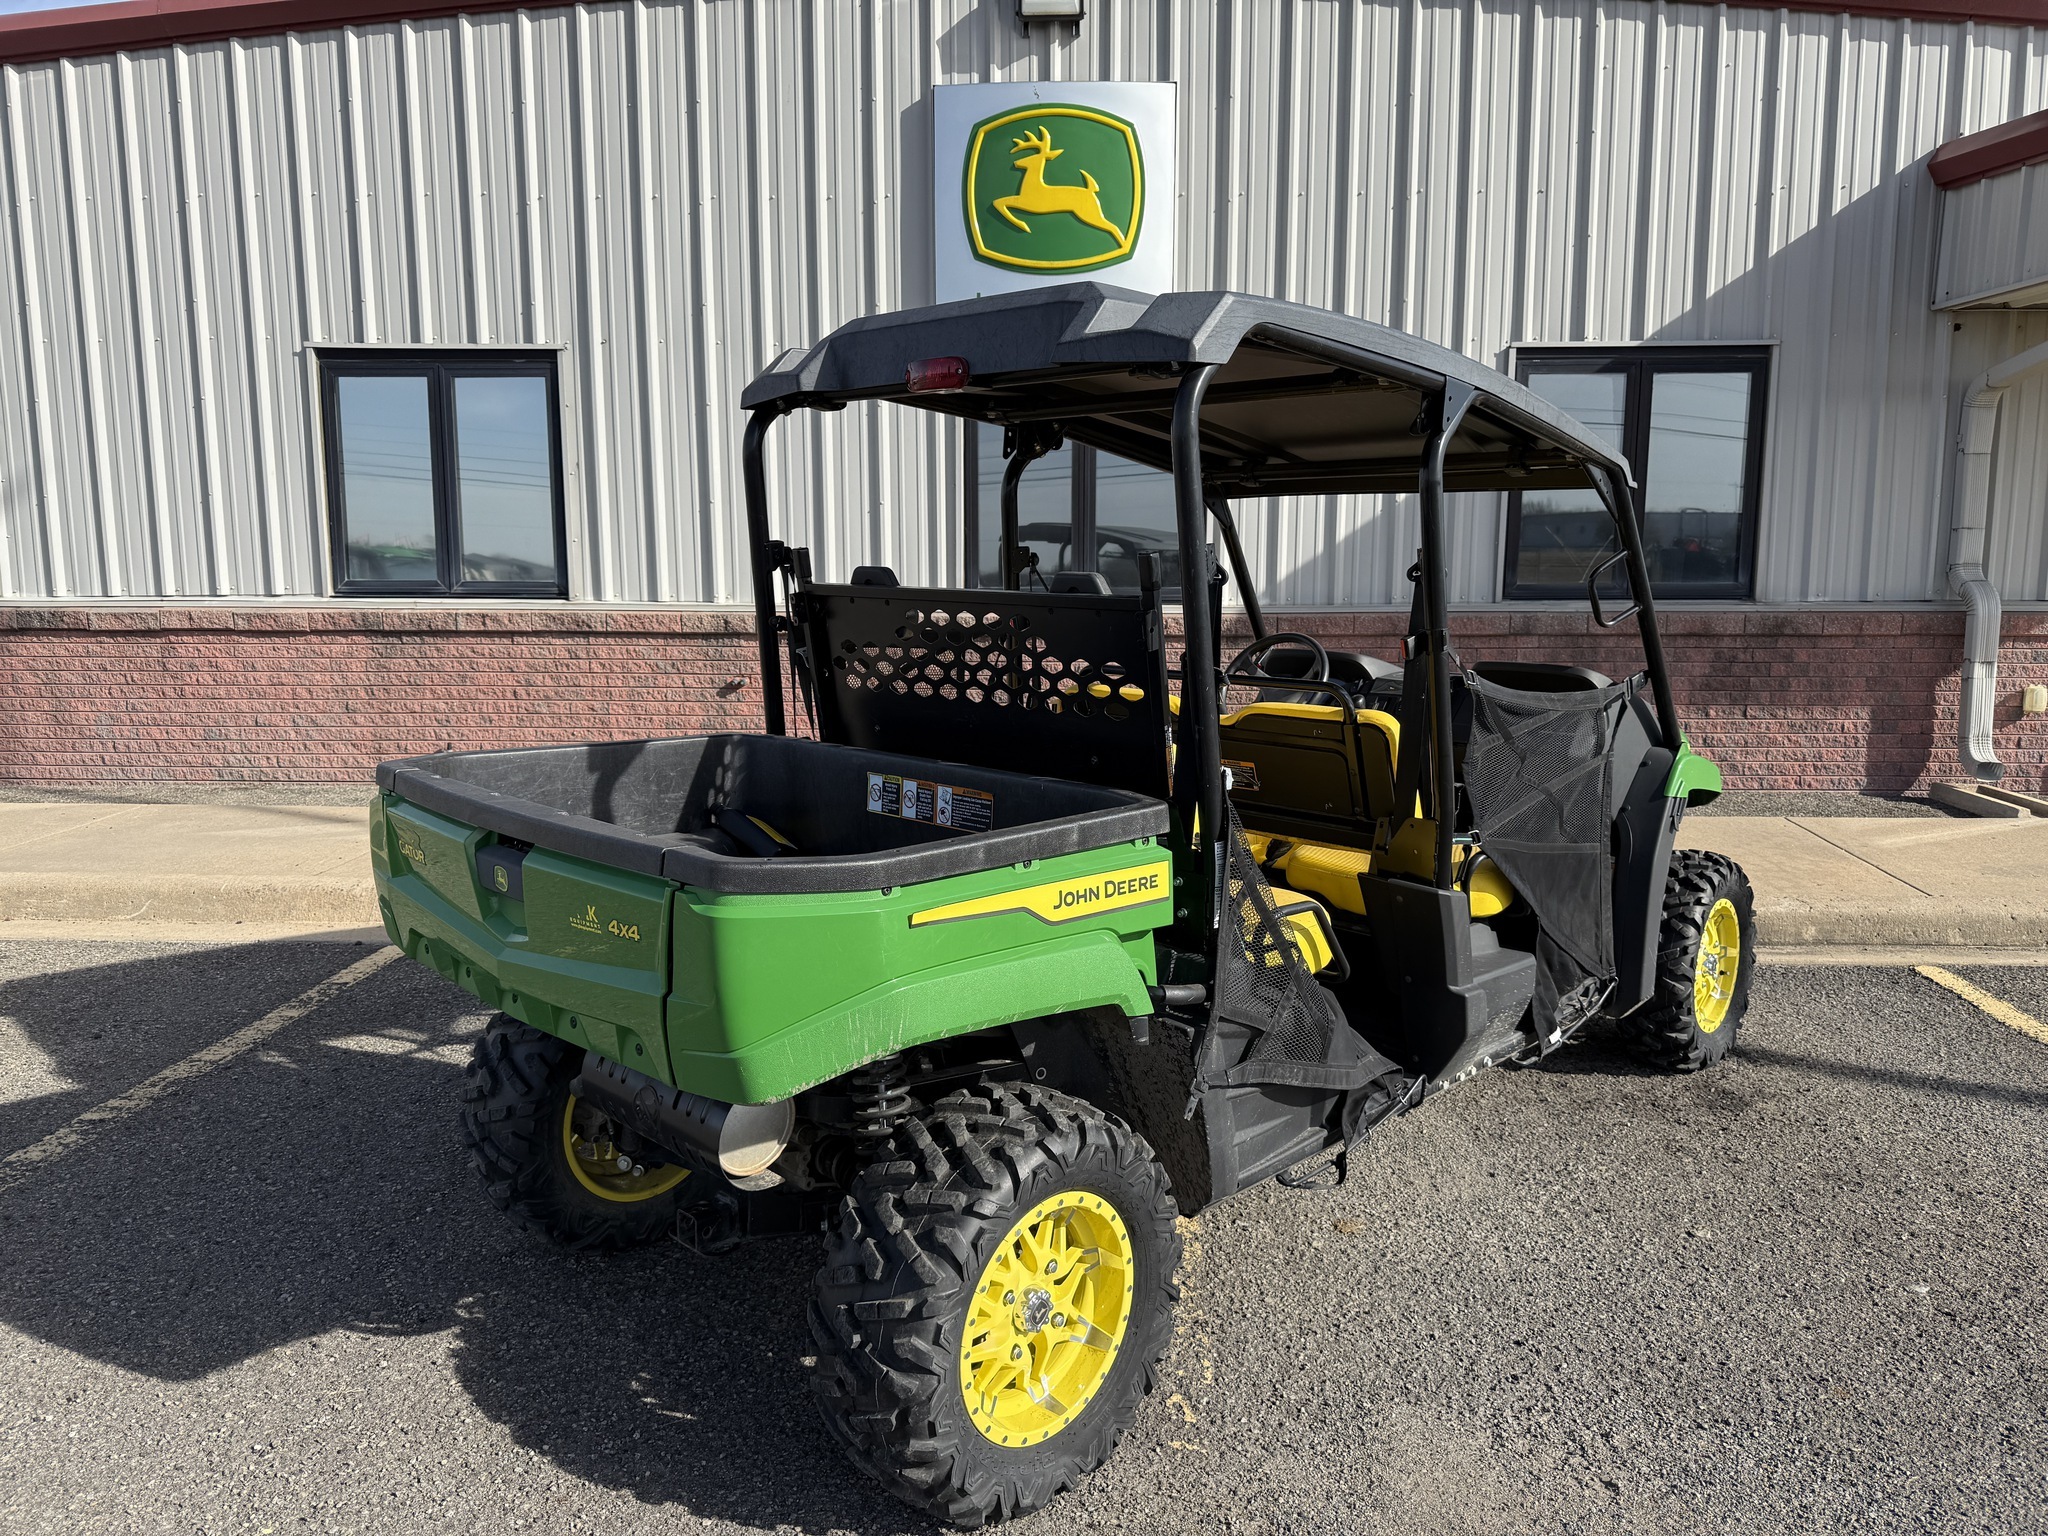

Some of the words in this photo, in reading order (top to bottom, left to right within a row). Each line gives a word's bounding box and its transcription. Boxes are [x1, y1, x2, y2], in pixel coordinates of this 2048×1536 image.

[398, 839, 426, 864] GATOR
[1053, 885, 1100, 910] JOHN
[1104, 873, 1159, 899] DEERE
